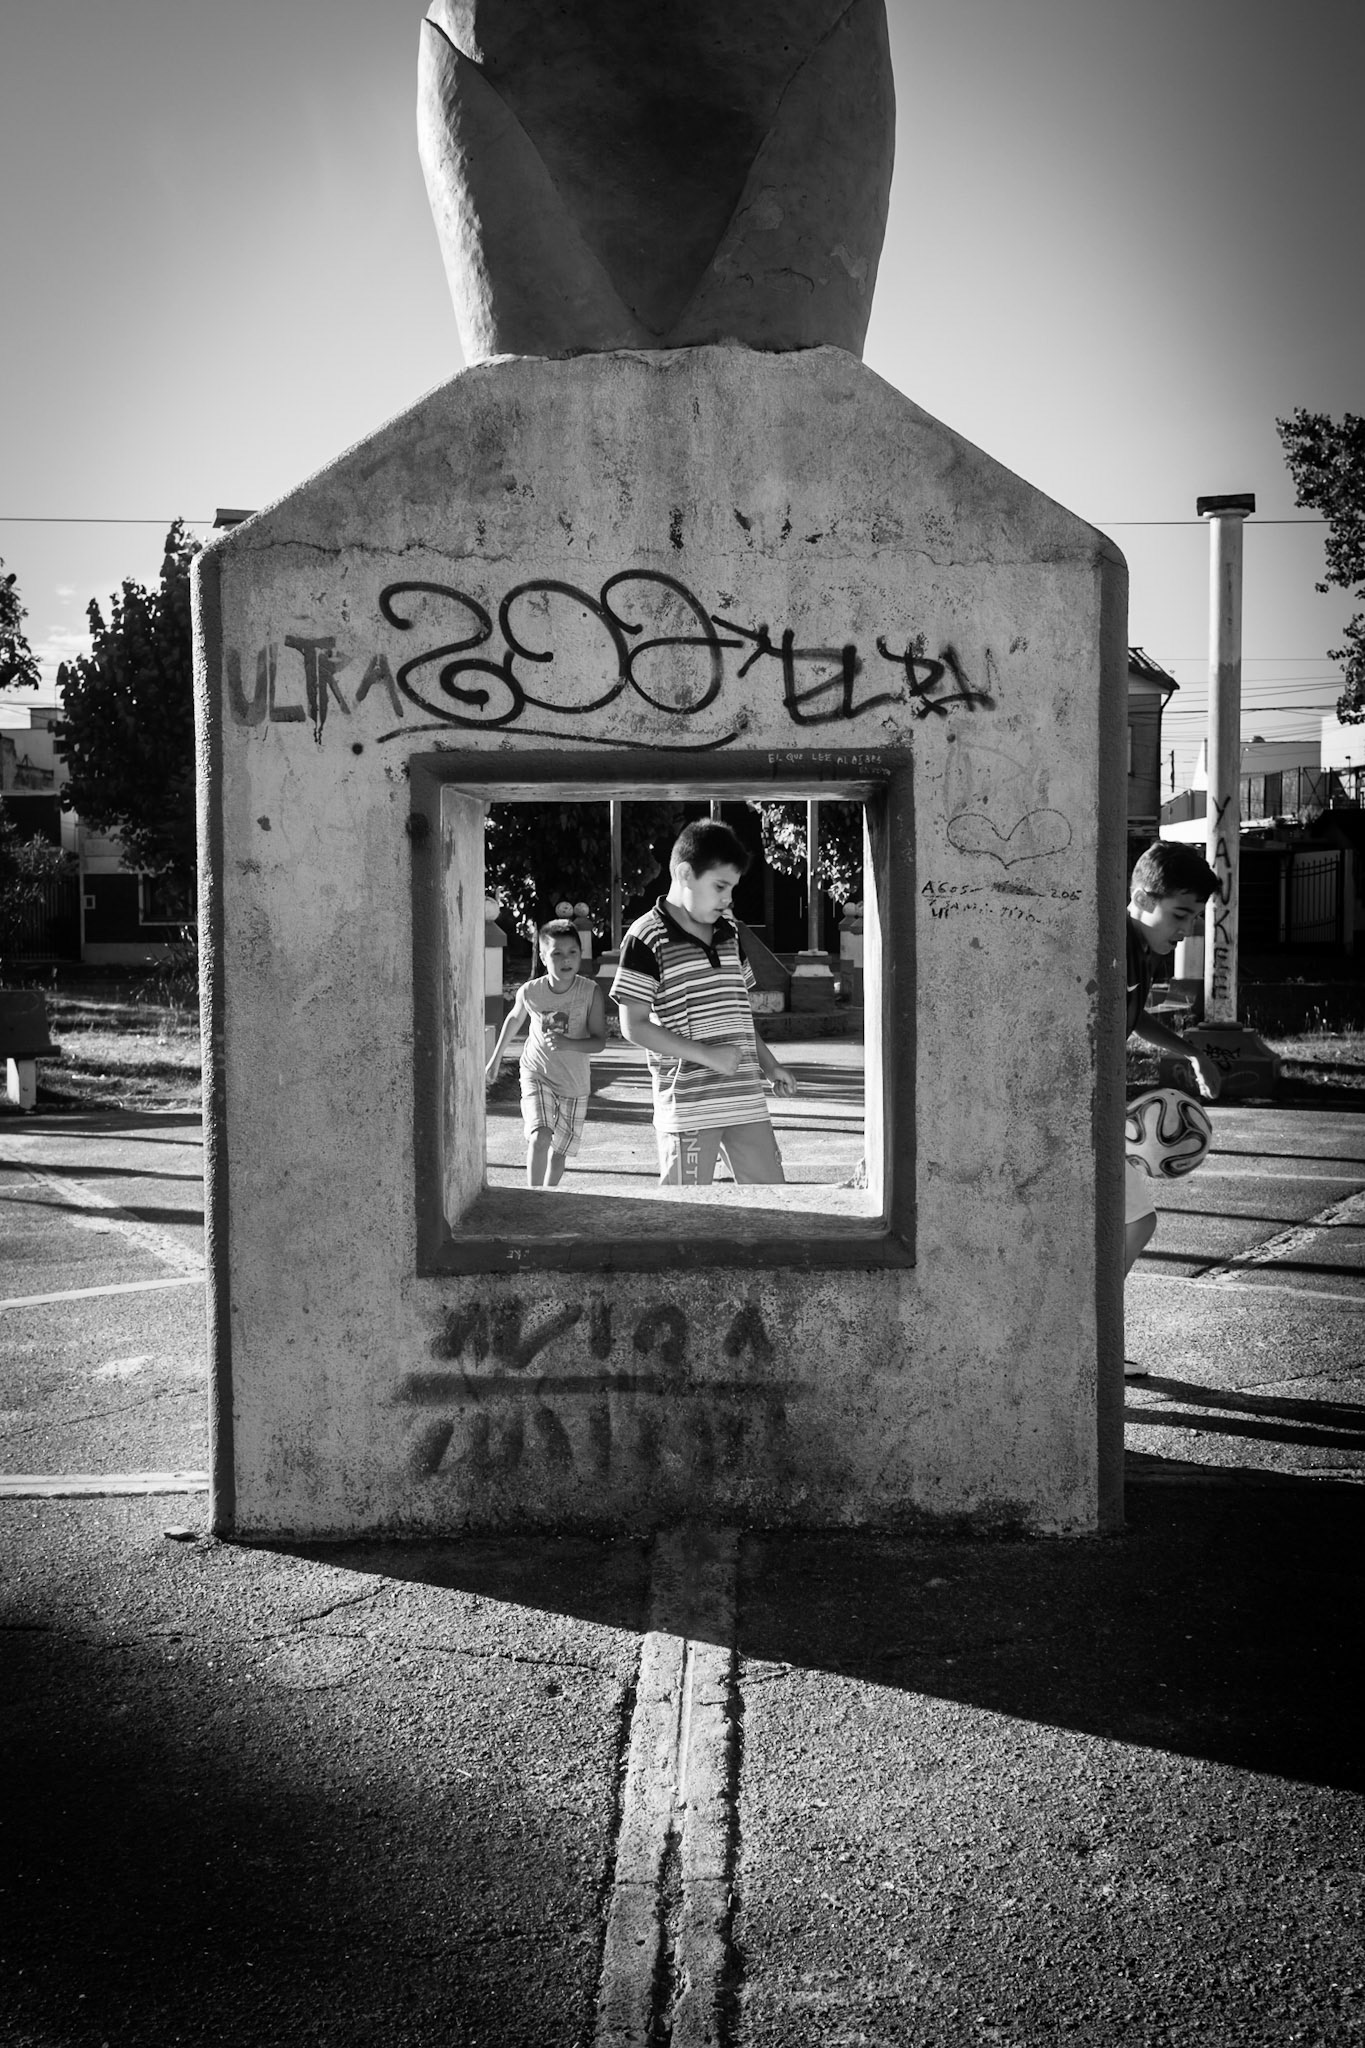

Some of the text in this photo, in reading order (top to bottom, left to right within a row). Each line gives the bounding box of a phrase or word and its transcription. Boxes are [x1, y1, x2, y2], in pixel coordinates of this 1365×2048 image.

[226, 635, 404, 735] ULTRA
[768, 753, 783, 764] EL
[812, 752, 832, 762] LEE
